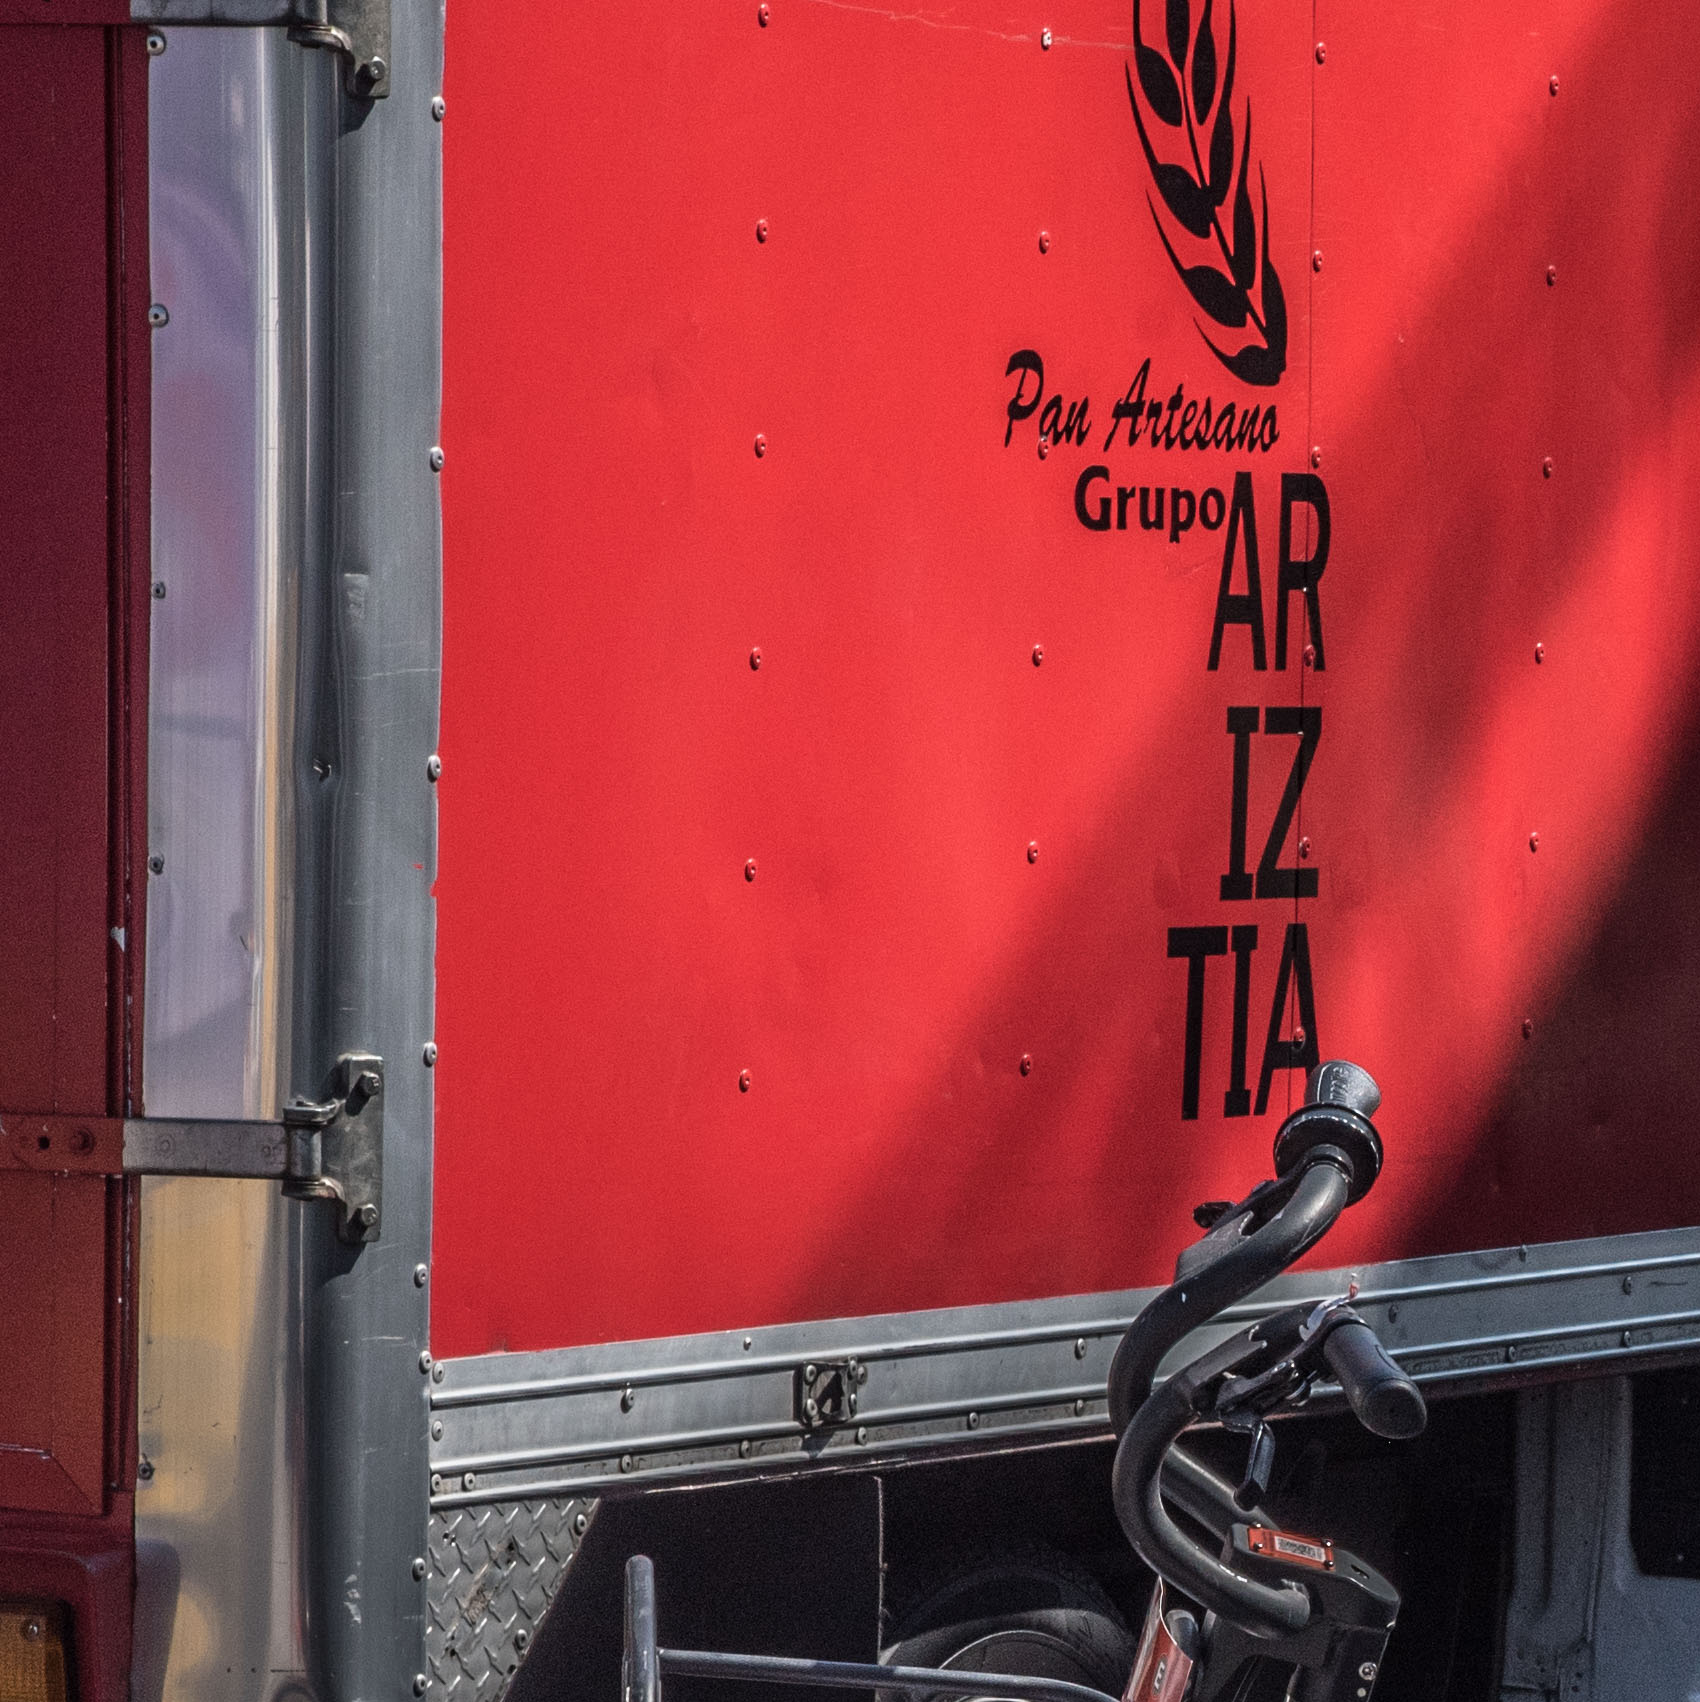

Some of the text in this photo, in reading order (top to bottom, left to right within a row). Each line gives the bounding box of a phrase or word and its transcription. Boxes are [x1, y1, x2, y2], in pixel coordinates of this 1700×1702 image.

[1004, 349, 1280, 454] Pan Artesano
[1074, 466, 1226, 542] Grupo
[1207, 471, 1332, 671] AR
[1219, 705, 1323, 901] IZ
[1167, 923, 1321, 1121] TIA
